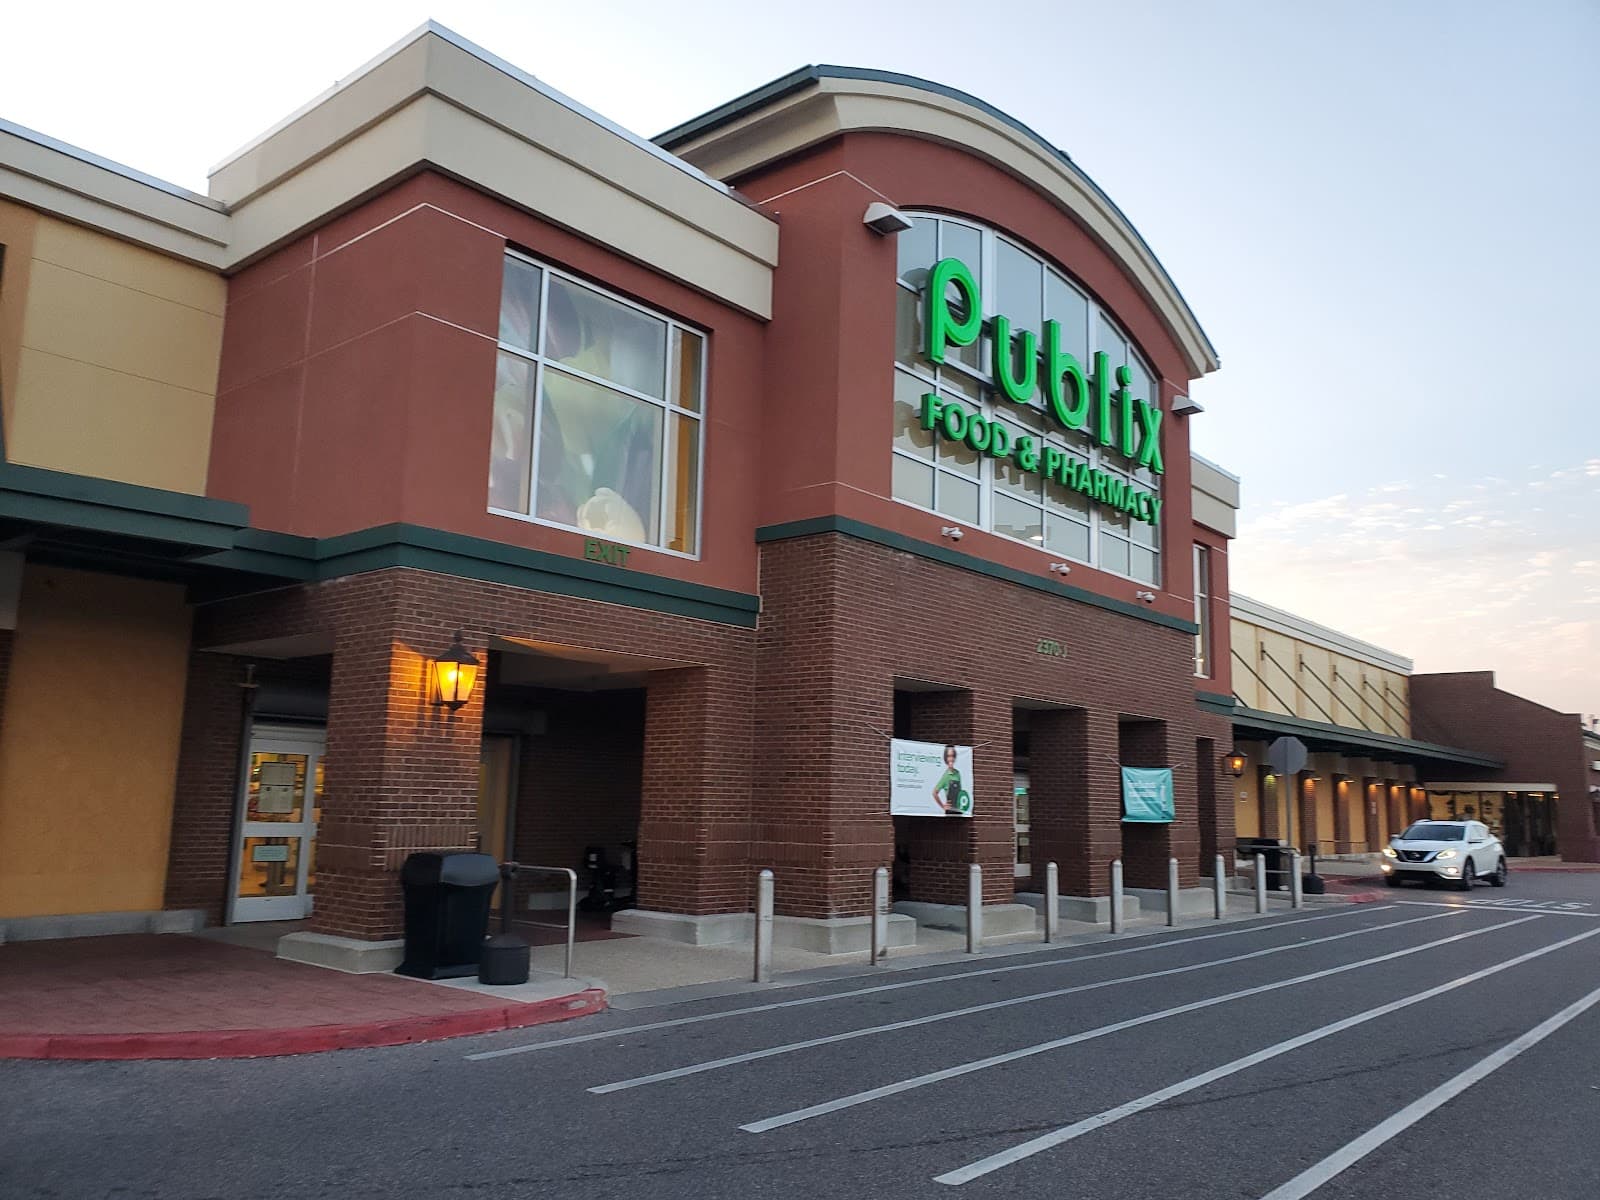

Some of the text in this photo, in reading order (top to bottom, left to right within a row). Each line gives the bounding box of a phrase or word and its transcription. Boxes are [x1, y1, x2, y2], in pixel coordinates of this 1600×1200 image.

[924, 257, 1164, 475] Publix
[920, 392, 1162, 526] FOOD & PHARMACY
[585, 539, 630, 566] EXIT
[1464, 898, 1592, 909] STOP
